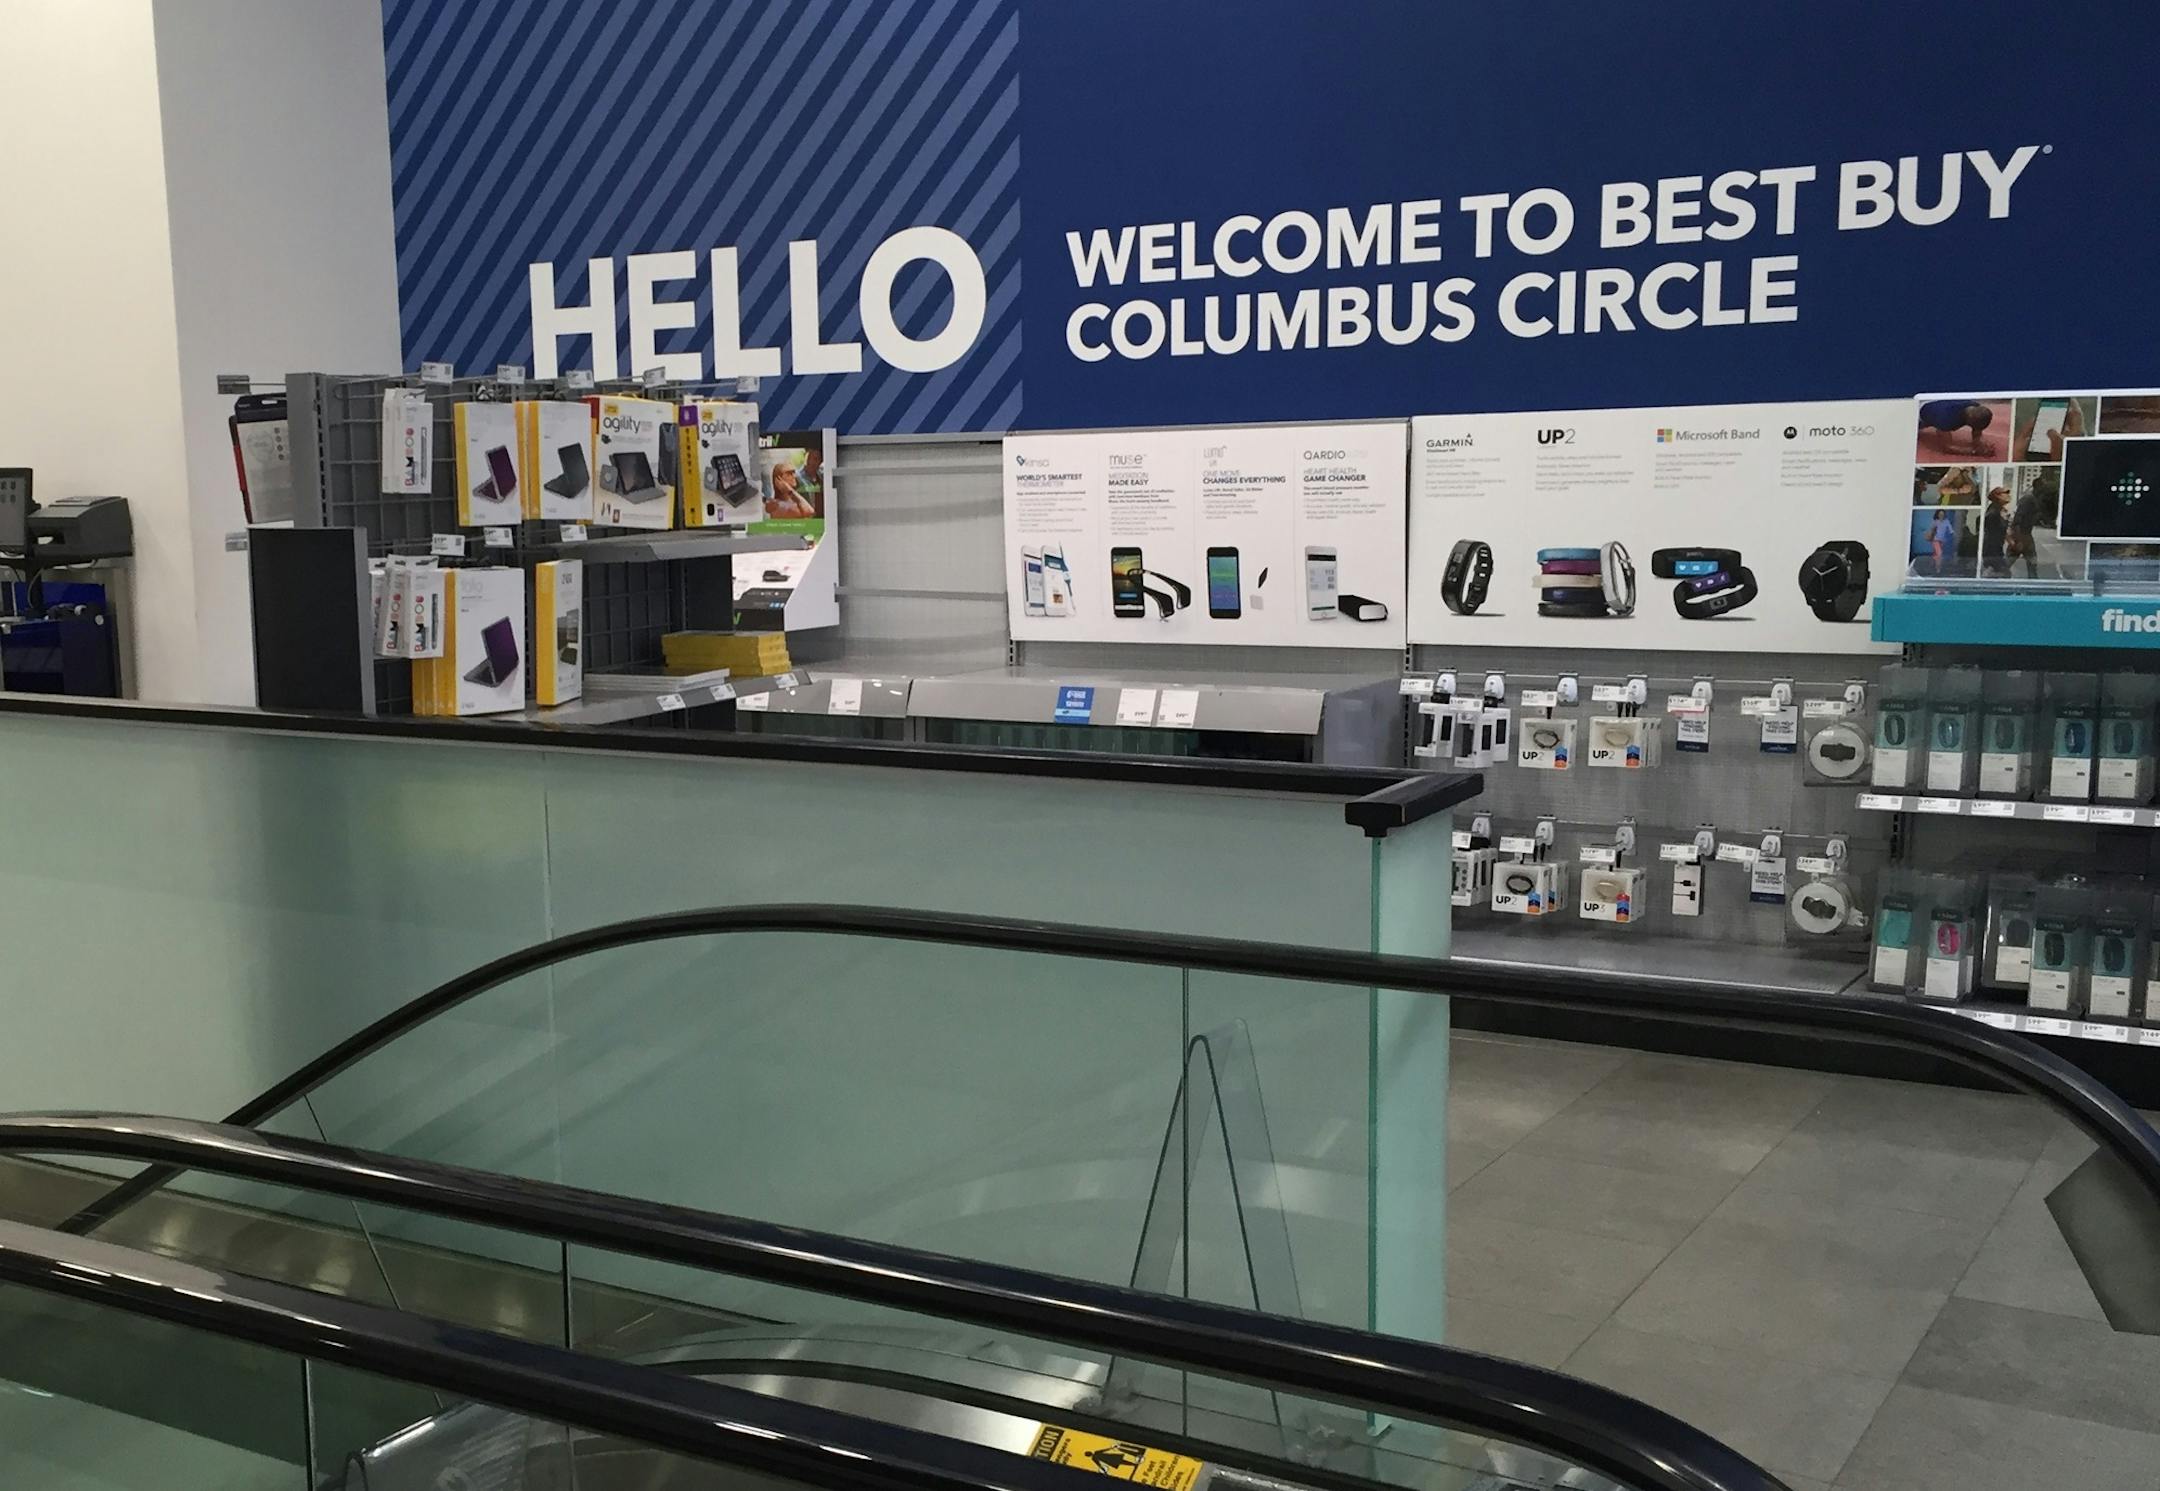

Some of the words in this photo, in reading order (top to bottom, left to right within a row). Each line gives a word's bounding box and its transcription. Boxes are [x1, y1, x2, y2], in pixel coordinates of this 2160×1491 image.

[1066, 200, 1441, 287] WELCOME
[1461, 188, 1574, 257] TO
[1601, 166, 1816, 248] BEST
[1839, 146, 2040, 230] BUY
[529, 226, 987, 382] HELLO
[1066, 278, 1475, 362] COLUMBUS
[1499, 256, 1799, 338] CIRCLE
[603, 416, 641, 435] agility
[1809, 425, 1846, 437] moto
[1849, 425, 1875, 437] 360
[1537, 428, 1576, 445] UP2
[1675, 428, 1728, 441] Microsoft
[1731, 428, 1760, 440] Band
[1426, 438, 1473, 448] GARMIN
[1109, 453, 1143, 466] muse
[1303, 450, 1346, 461] QARDIO
[1016, 473, 1046, 482] WORLD'S
[1048, 473, 1082, 481] SMARTEST
[1203, 476, 1238, 485] CHANGES
[1239, 475, 1286, 484] EVERYTHING
[1328, 474, 1366, 482] CHANGER
[2102, 608, 2160, 632] find
[1592, 749, 1615, 759] UP2
[1495, 894, 1518, 905] UP2
[1160, 1455, 1180, 1487] Children
